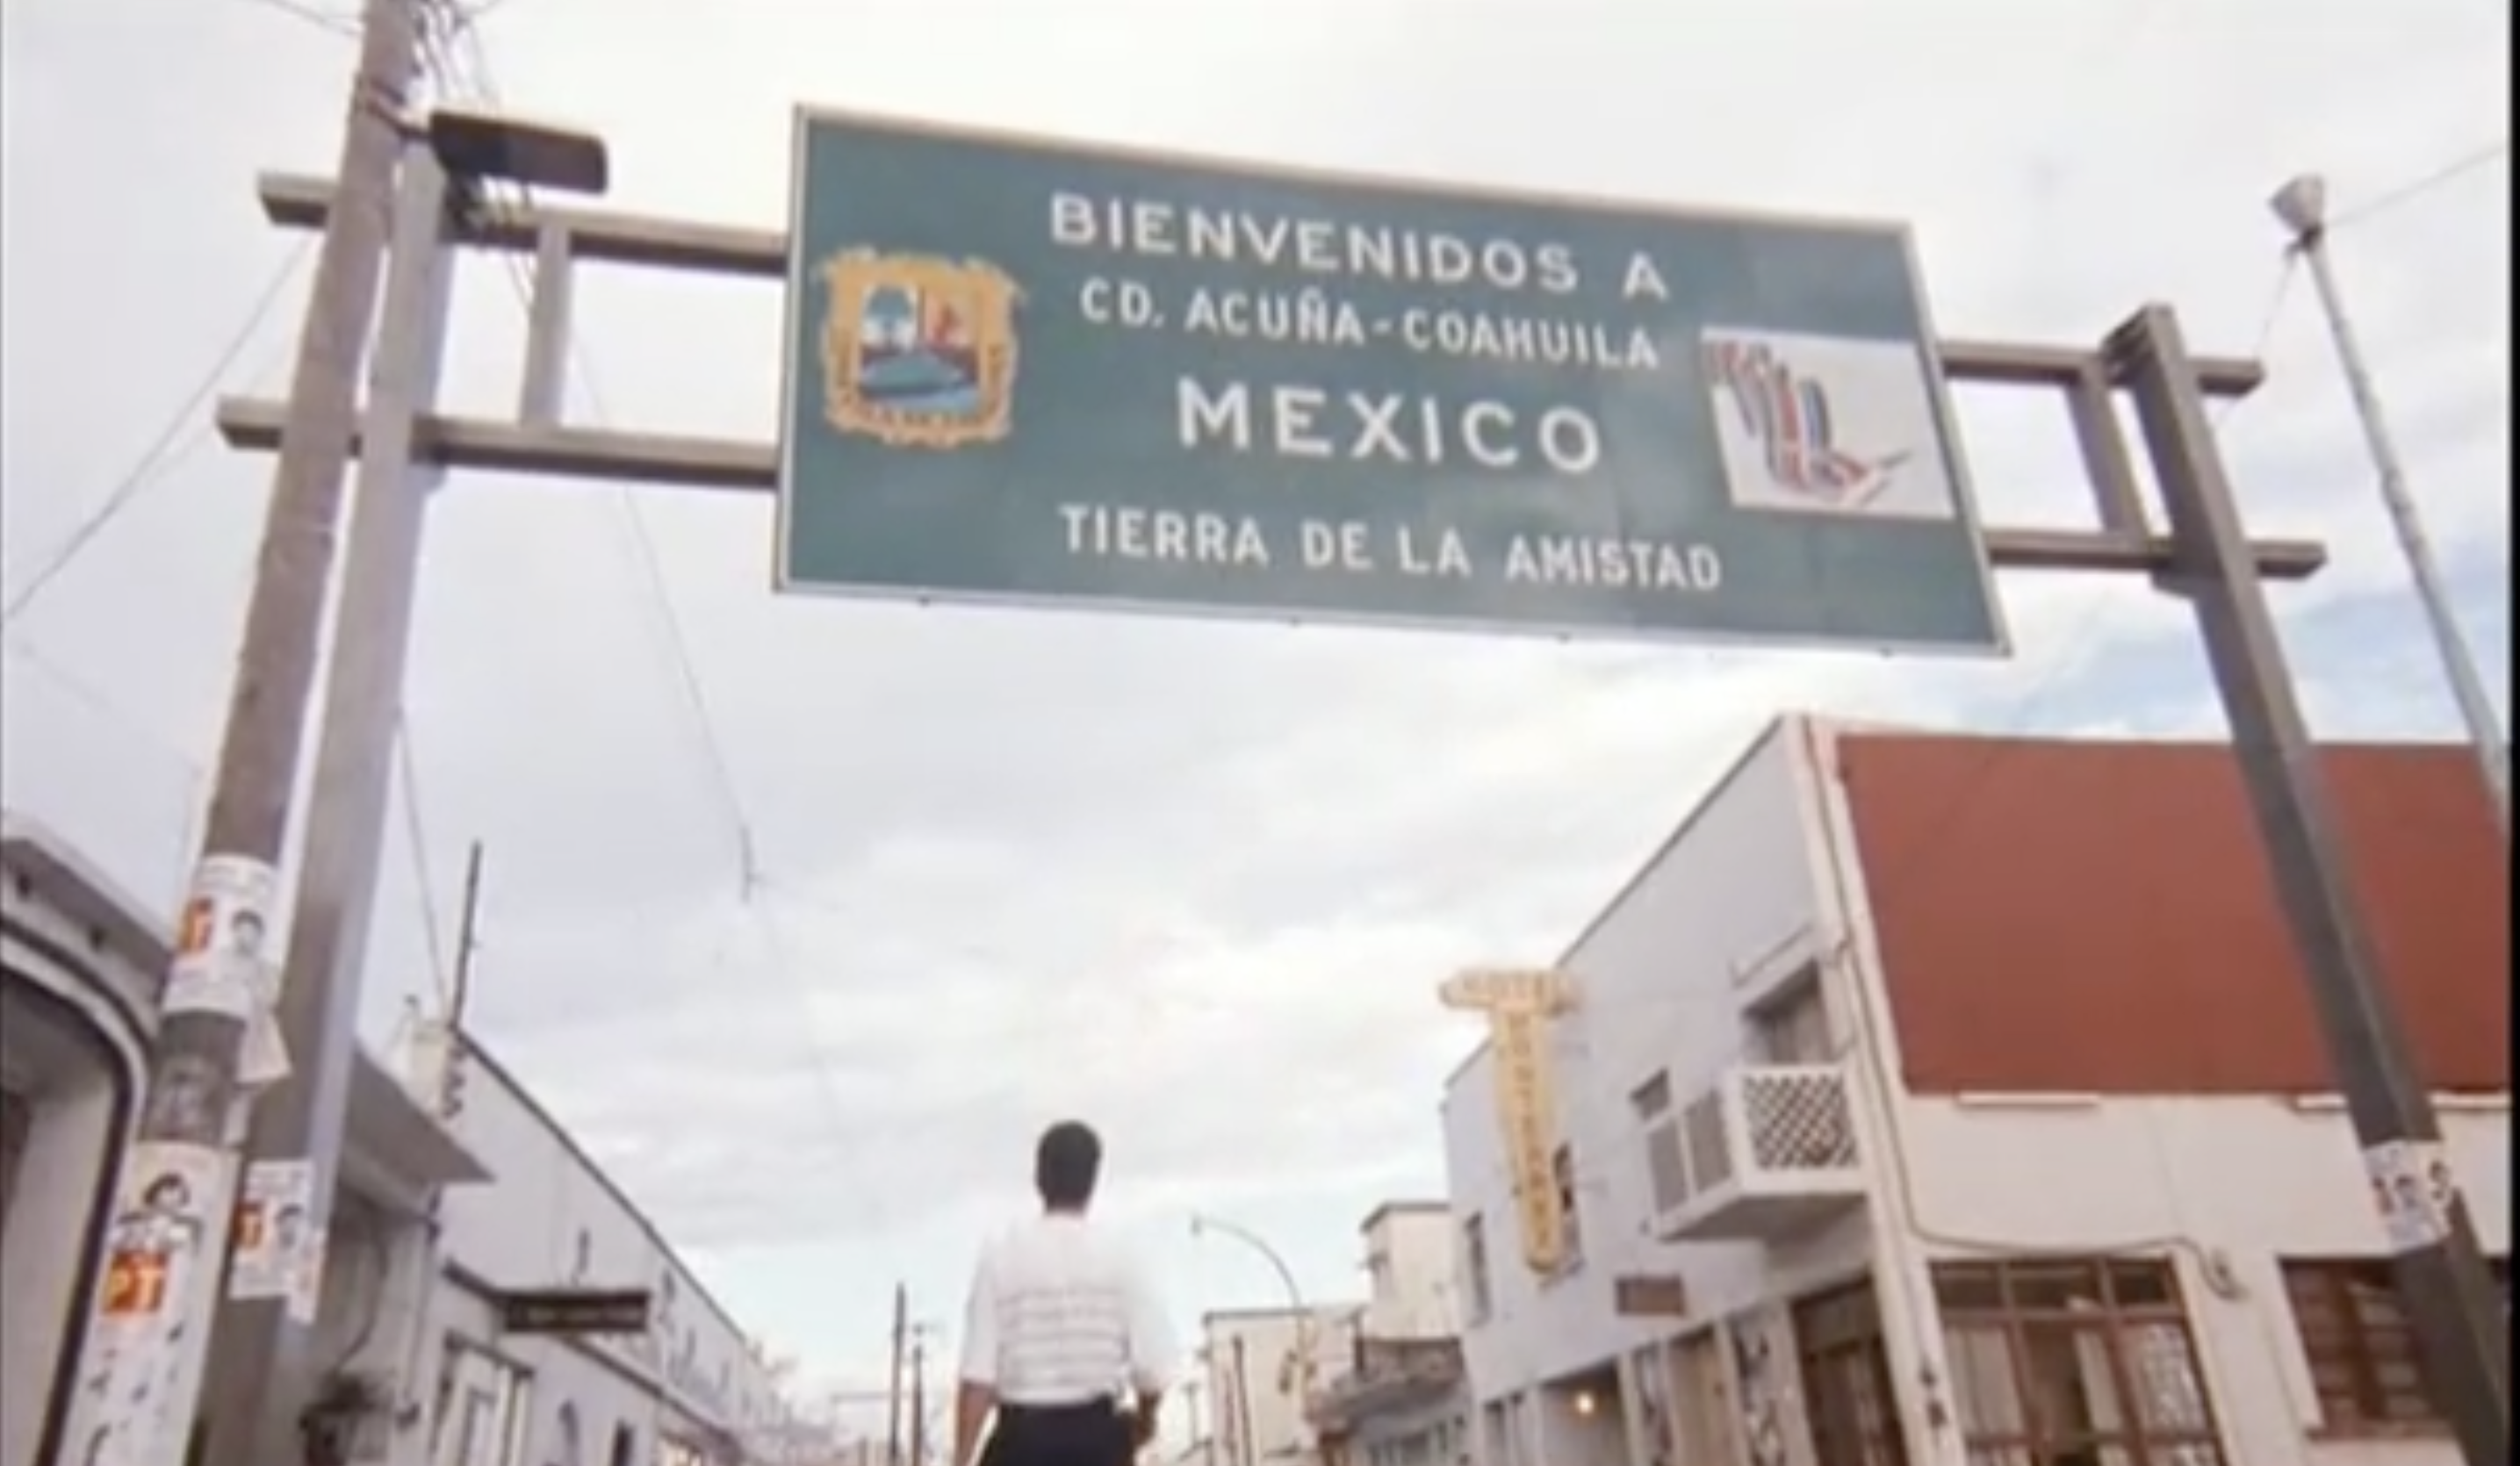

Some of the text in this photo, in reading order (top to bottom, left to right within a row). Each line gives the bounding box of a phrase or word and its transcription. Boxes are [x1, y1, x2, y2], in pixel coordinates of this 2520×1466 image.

[1049, 192, 1668, 300] BIENVENIDOS A
[1079, 276, 1164, 328] CD.
[1177, 375, 1601, 475] MEXICO
[1058, 502, 1721, 593] TIERRA DE LA AMISTAD
